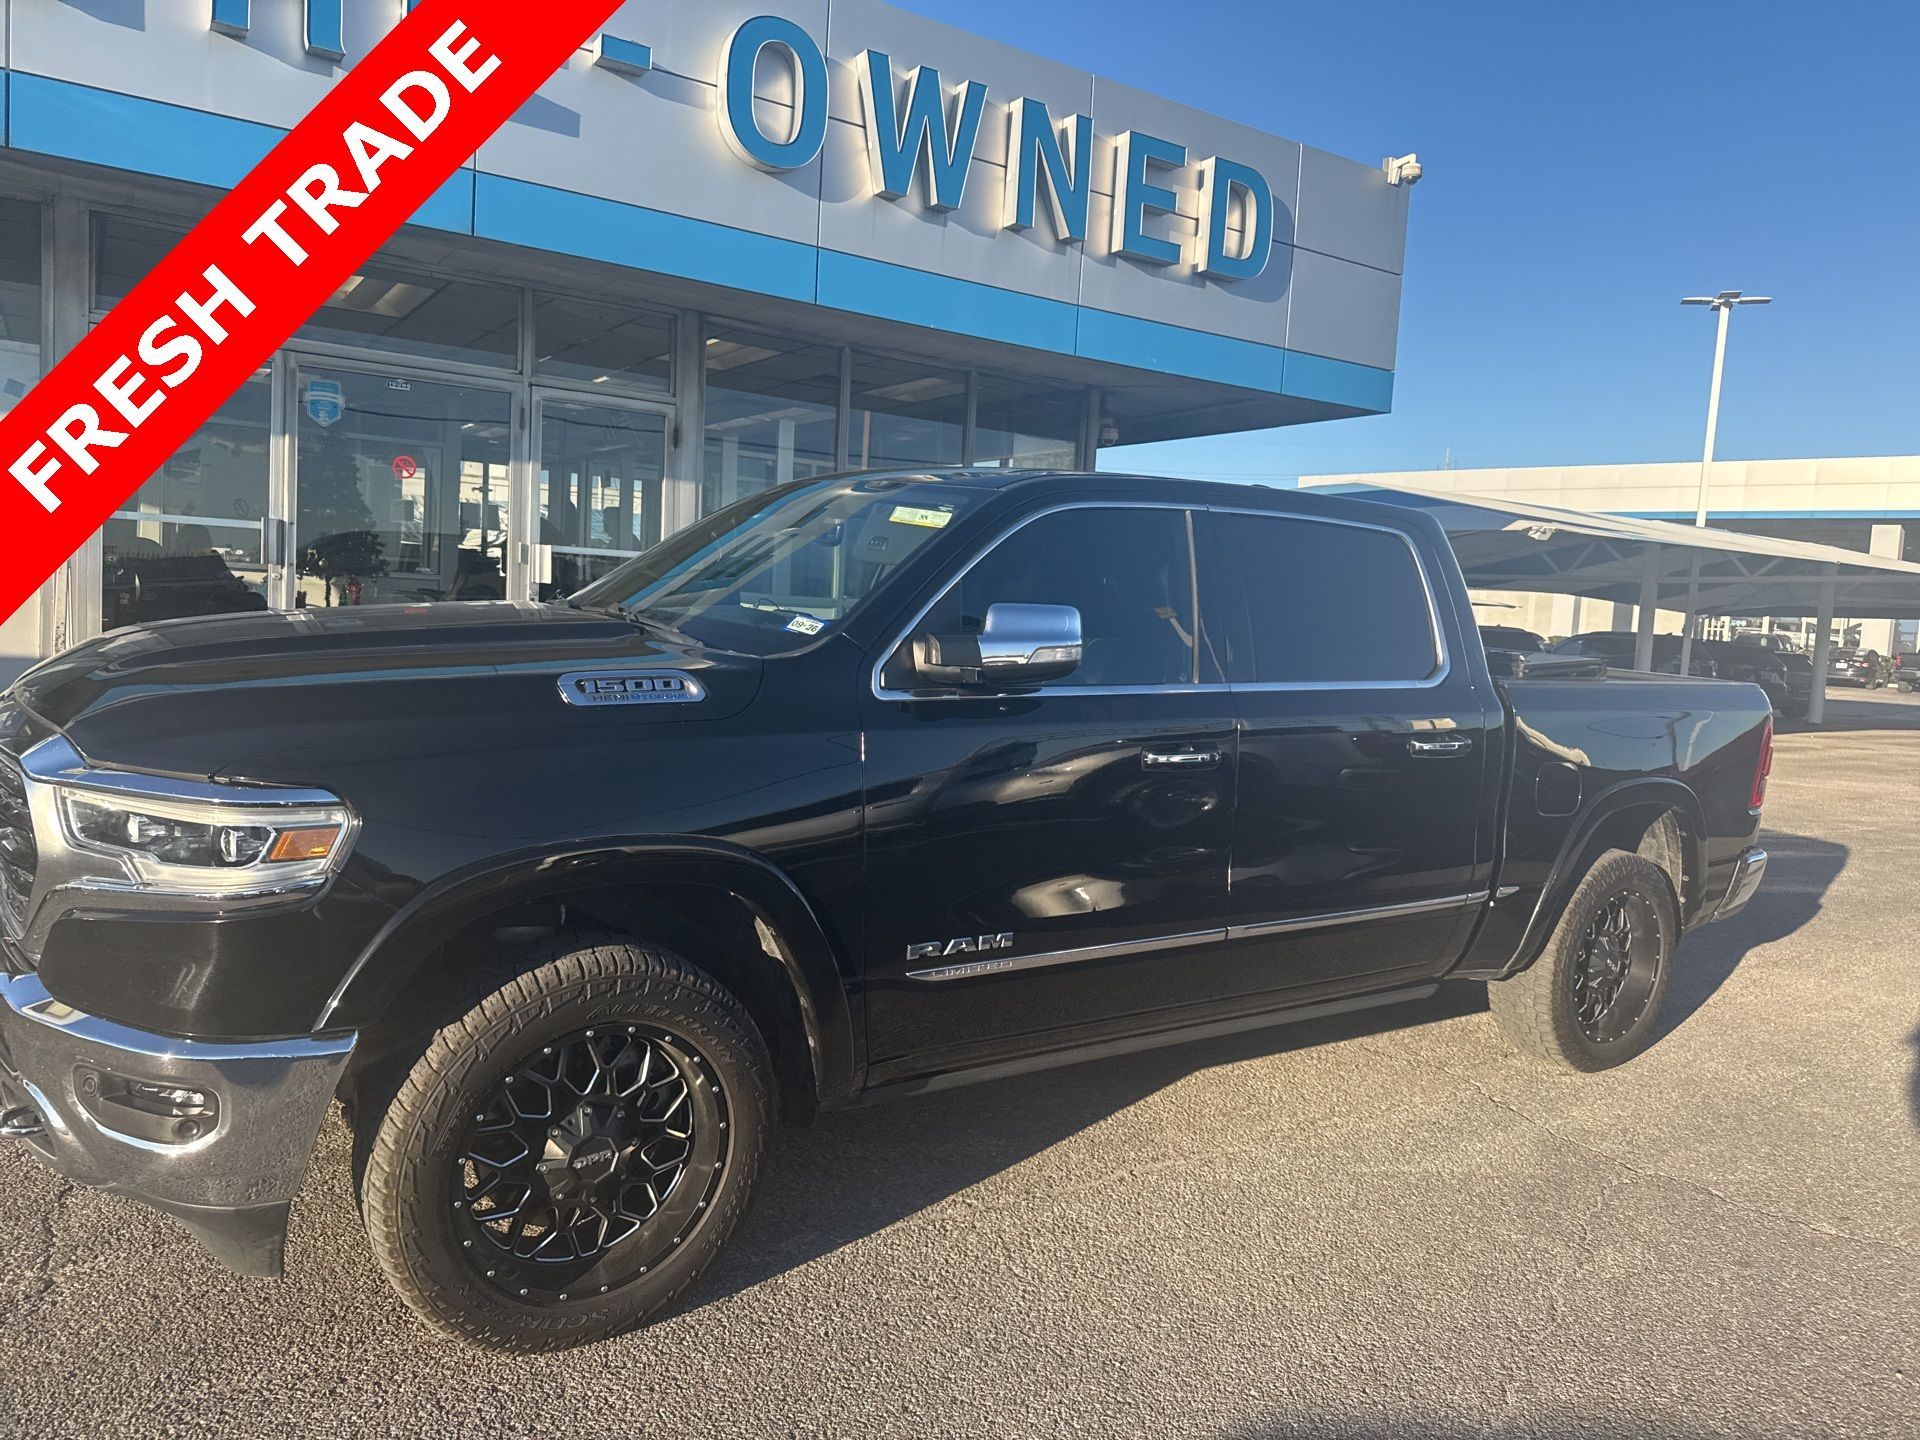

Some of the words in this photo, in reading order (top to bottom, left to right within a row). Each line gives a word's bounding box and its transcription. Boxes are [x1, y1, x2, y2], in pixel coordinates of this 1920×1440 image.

[585, 679, 682, 693] 1500
[906, 931, 1014, 961] RAM
[930, 961, 1013, 977] LIMITED
